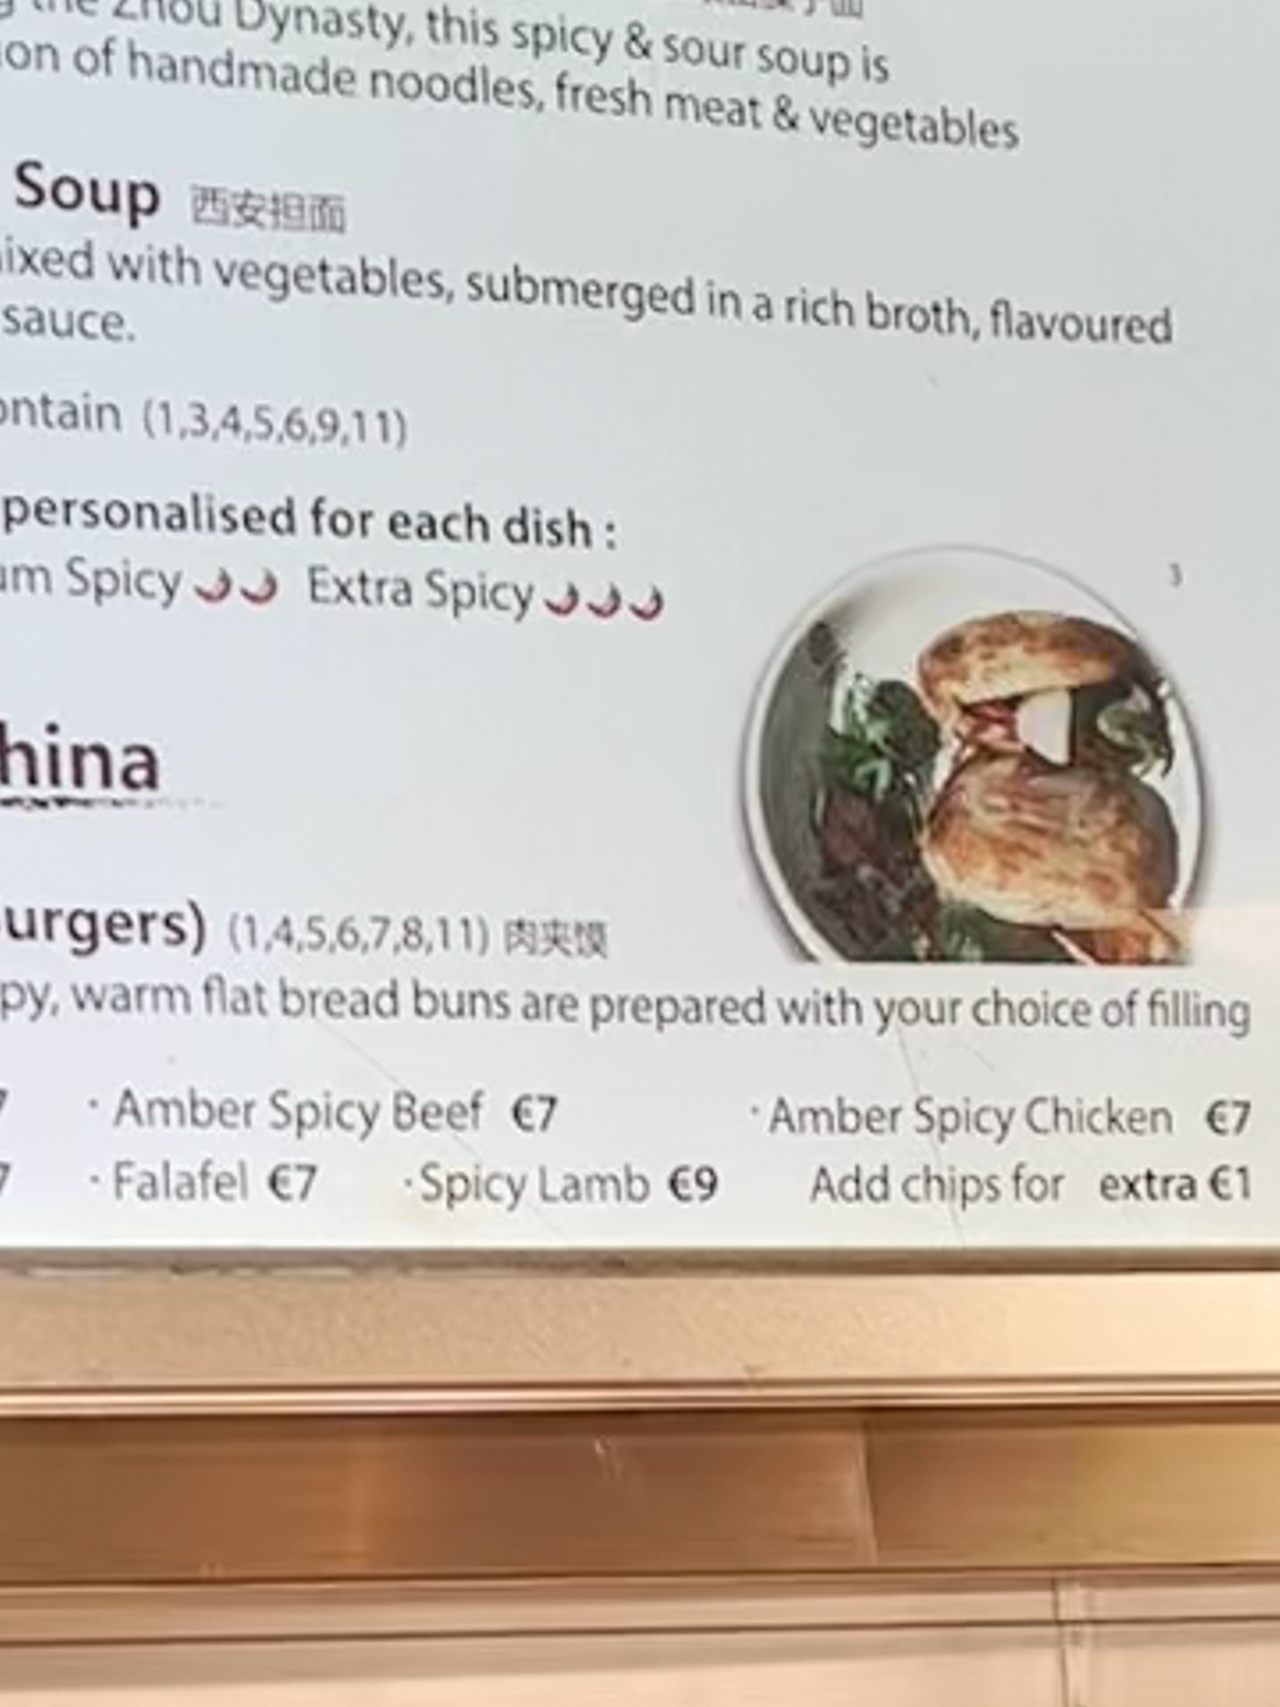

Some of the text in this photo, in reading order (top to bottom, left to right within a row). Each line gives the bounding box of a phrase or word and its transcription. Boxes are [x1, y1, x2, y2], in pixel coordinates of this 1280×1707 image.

[13, 158, 161, 231] Soup
[1, 491, 297, 537] personalised
[309, 494, 374, 539] for
[387, 501, 490, 543] each
[502, 504, 592, 549] dish
[112, 1086, 558, 1142] Amber Spicy Beef €7
[768, 1094, 1251, 1144] Amber Spicy Chicken €7
[113, 1157, 318, 1202] Falafel €7
[419, 1160, 718, 1212] Spicy Lamb €9
[809, 1161, 1250, 1212] Add chips for extra €1
